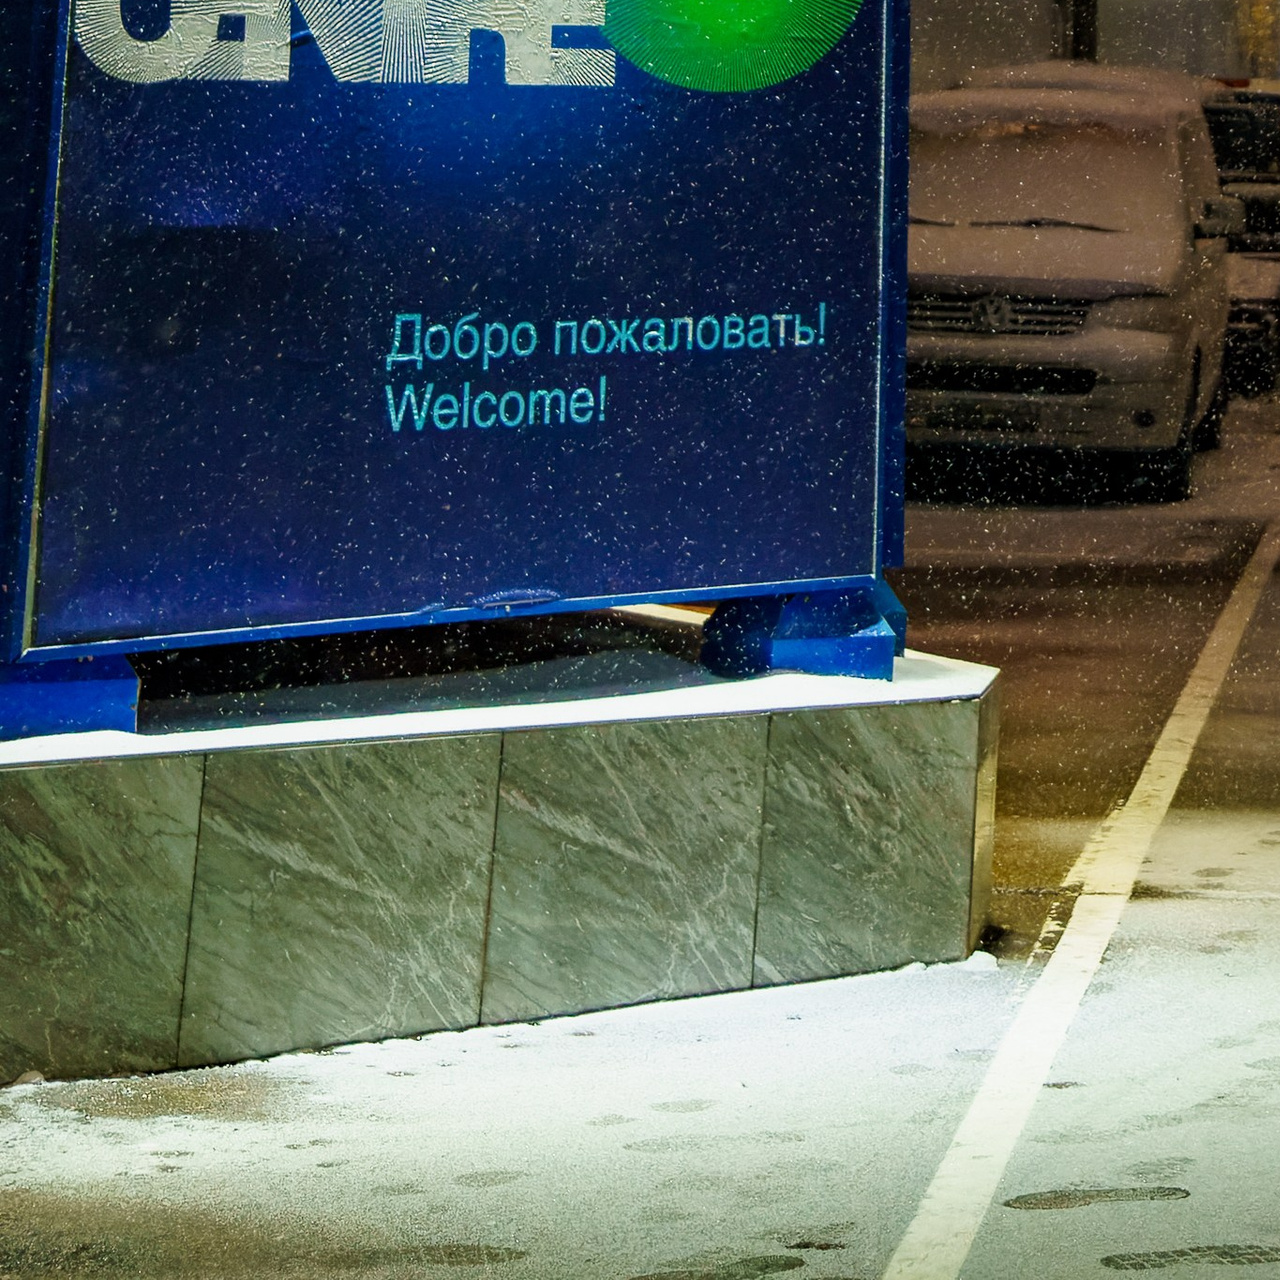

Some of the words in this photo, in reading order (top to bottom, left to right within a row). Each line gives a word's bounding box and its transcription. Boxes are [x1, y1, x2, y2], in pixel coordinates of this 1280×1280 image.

[386, 312, 538, 370] Добро
[554, 301, 827, 356] пожаловать!
[385, 376, 608, 432] Welcome!
